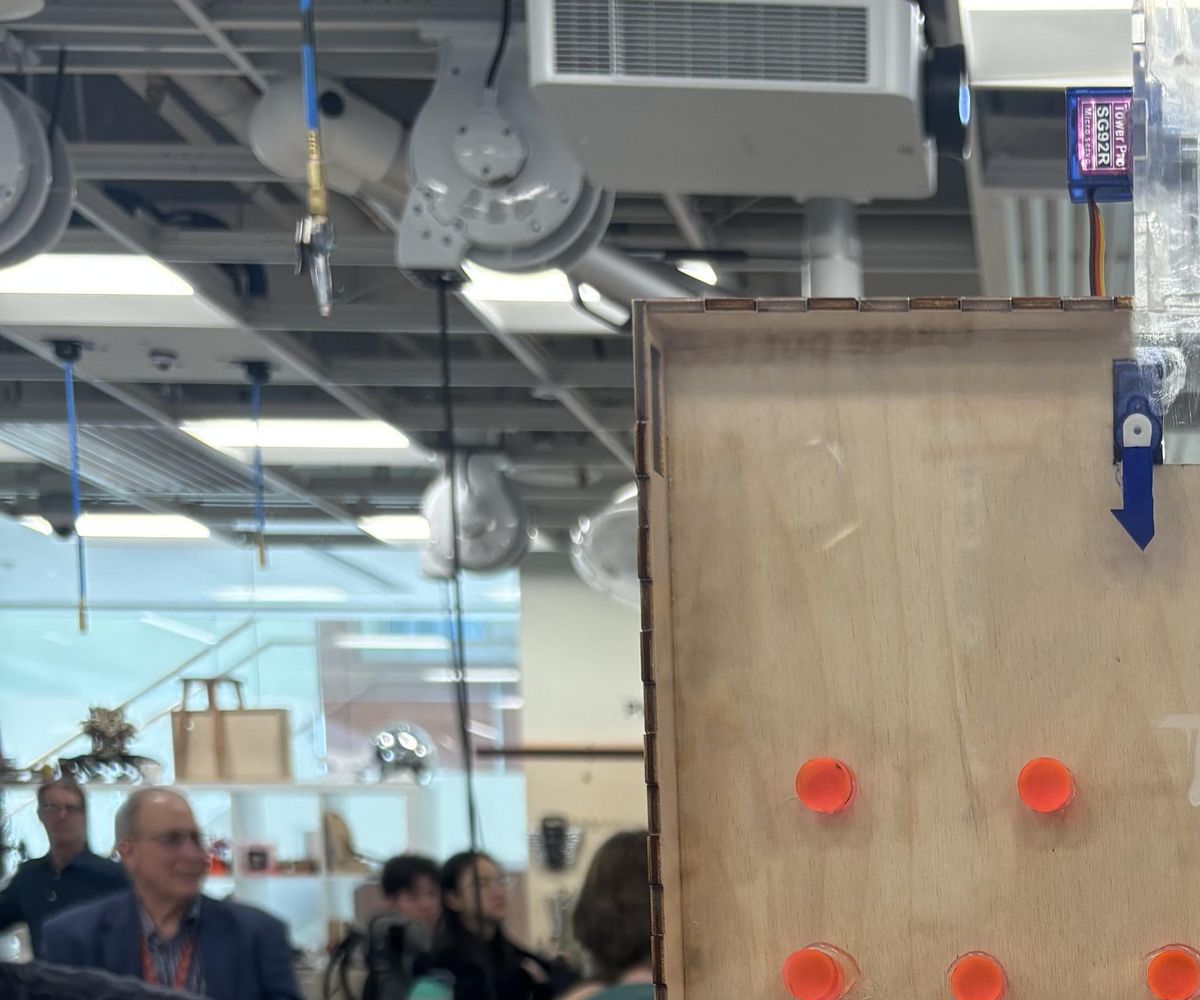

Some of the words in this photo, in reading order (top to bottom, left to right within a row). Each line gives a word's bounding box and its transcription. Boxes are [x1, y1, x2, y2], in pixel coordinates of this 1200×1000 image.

[1084, 108, 1092, 135] Micro
[1096, 106, 1110, 166] SG92R
[1114, 104, 1128, 143] Tower
[1115, 145, 1128, 167] Pro
